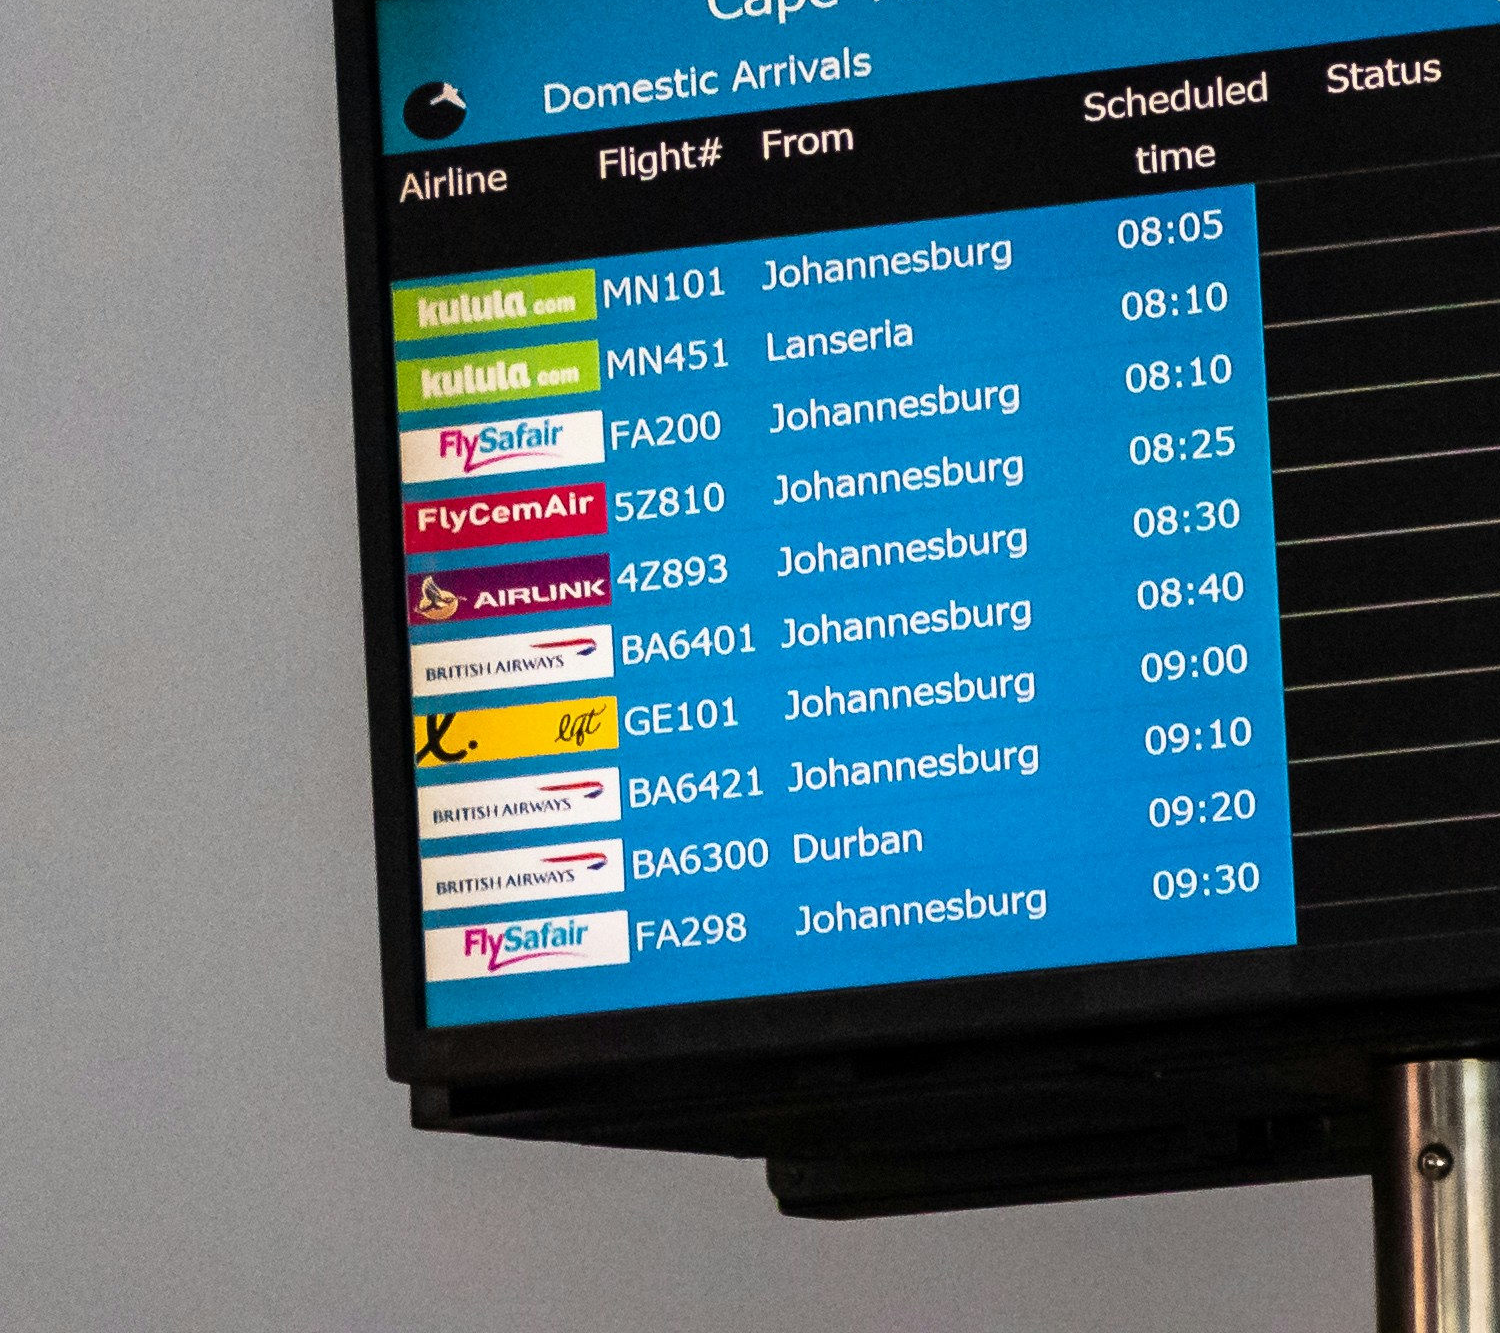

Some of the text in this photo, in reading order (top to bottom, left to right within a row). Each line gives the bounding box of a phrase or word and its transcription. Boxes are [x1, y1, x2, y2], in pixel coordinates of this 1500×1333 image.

[543, 46, 872, 114] Domestic Arrivals
[1083, 70, 1268, 122] Scheduled
[1326, 58, 1442, 94] Status
[599, 136, 723, 182] Flight#
[762, 128, 854, 161] From
[1135, 143, 1216, 175] time
[399, 166, 508, 203] Airline
[1117, 209, 1224, 249] 08:05
[762, 240, 1012, 291] Johannesburg
[603, 266, 725, 309] MN101
[1121, 281, 1228, 321] 08:10
[418, 290, 526, 328] kulula
[607, 338, 729, 380] MN451
[766, 319, 913, 362] Lanseria
[421, 361, 531, 399] kulula
[1125, 353, 1232, 394] 08:10
[769, 384, 1020, 434] Johannesburg
[439, 419, 564, 473] FlySafair
[610, 410, 721, 451] FA200
[1129, 425, 1236, 466] 08:25
[773, 455, 1024, 506] Johannesburg
[417, 491, 594, 533] FlyCemAir
[615, 482, 725, 522] 5Z810
[1133, 498, 1240, 538] 08:30
[777, 527, 1028, 577] Johannesburg
[616, 553, 728, 593] 4Z893
[1137, 571, 1244, 611] 08:40
[473, 579, 606, 610] AIRLINK
[621, 623, 756, 665] BA6401
[781, 599, 1032, 649] Johannesburg
[425, 654, 564, 681] BRITISH AIRWAYS
[1141, 644, 1248, 683] 09:00
[624, 696, 738, 736] GE101
[784, 671, 1035, 721] Johannesburg
[1145, 716, 1252, 756] 09:10
[628, 766, 764, 809] BA6421
[788, 743, 1039, 792] Johannesburg
[432, 797, 571, 824] BRITISH AIRWAYS
[1149, 789, 1256, 828] 09:20
[632, 838, 769, 880] BA6300
[793, 826, 923, 864] Durban
[435, 869, 575, 896] BRITISH AIRWAYS
[1153, 862, 1260, 901] 09:30
[636, 912, 747, 951] FA298
[795, 888, 1047, 936] Johannesburg
[464, 919, 588, 973] FlySafair
